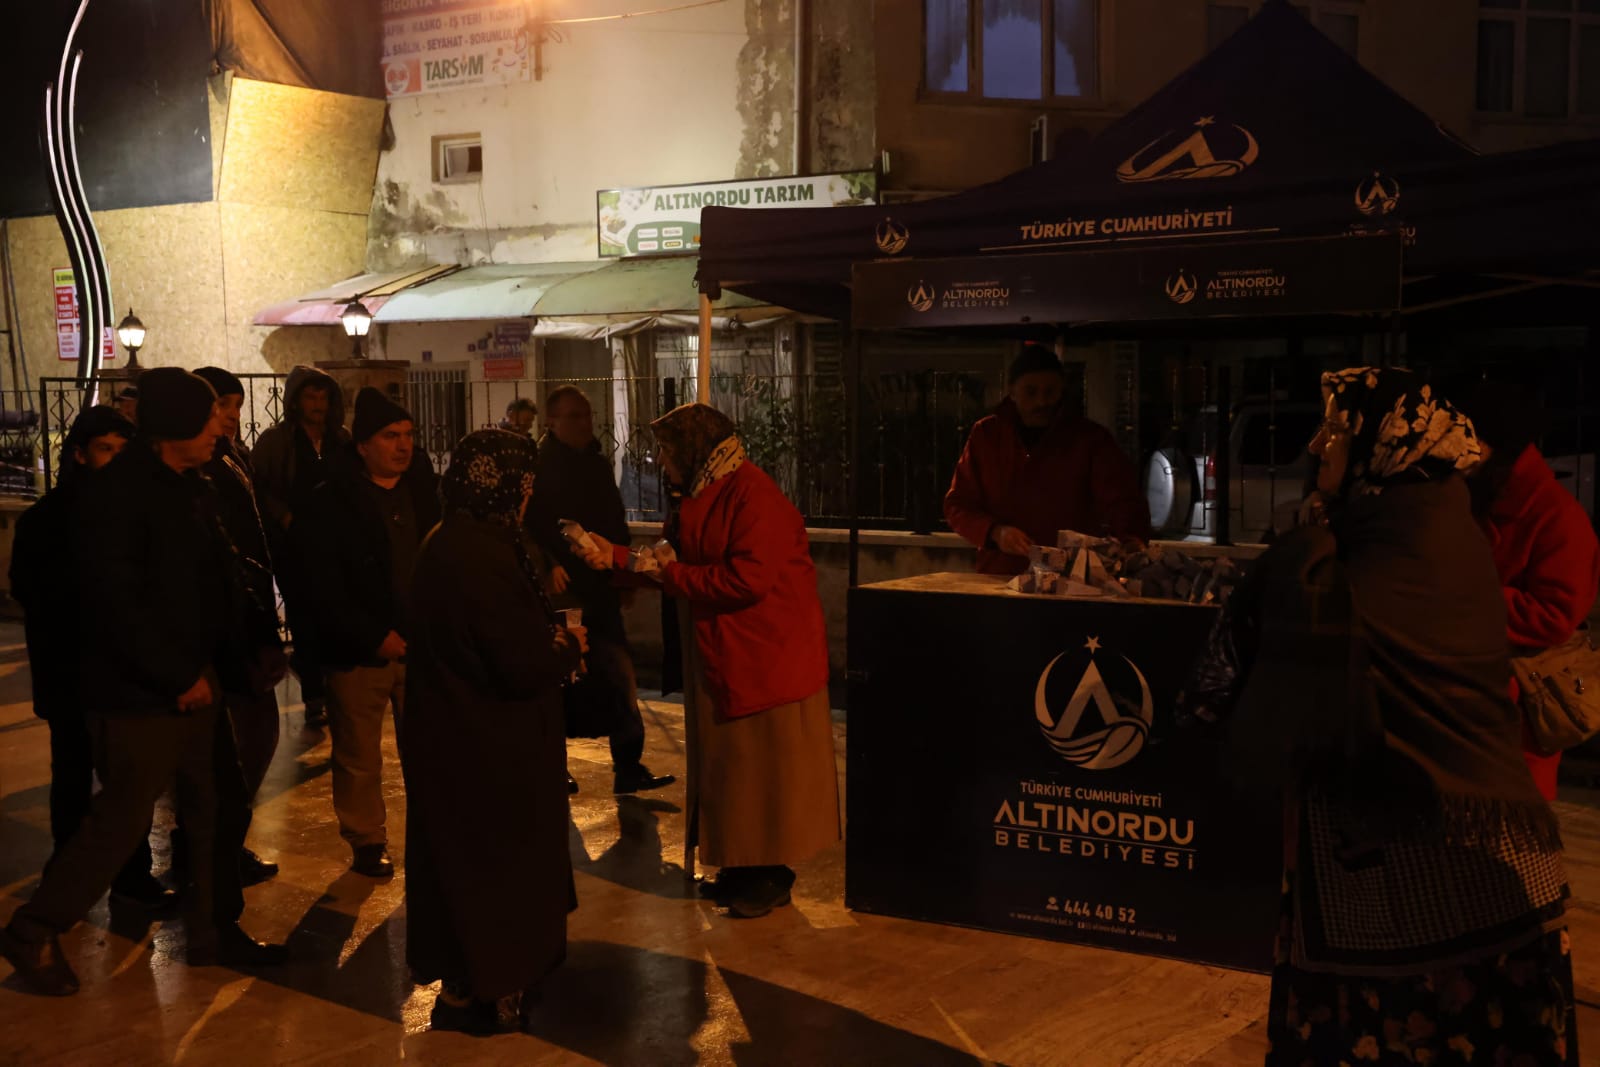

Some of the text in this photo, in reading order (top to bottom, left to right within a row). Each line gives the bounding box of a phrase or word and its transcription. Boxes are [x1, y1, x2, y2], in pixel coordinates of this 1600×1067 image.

[426, 35, 463, 51] SEYAHAT
[654, 183, 815, 211] ALTINORDU TARIM
[1020, 205, 1233, 240] TÜRKİYE CUMHURİYETİ
[943, 287, 1010, 301] ALTINORDU
[1206, 276, 1286, 290] ALTINORDU
[1019, 779, 1164, 809] TÜRKİYE CUMHURİYETİ
[993, 799, 1196, 846] ALTINORDU
[994, 829, 1195, 871] BELEDİYESİ
[1063, 899, 1137, 924] 444 40 52
